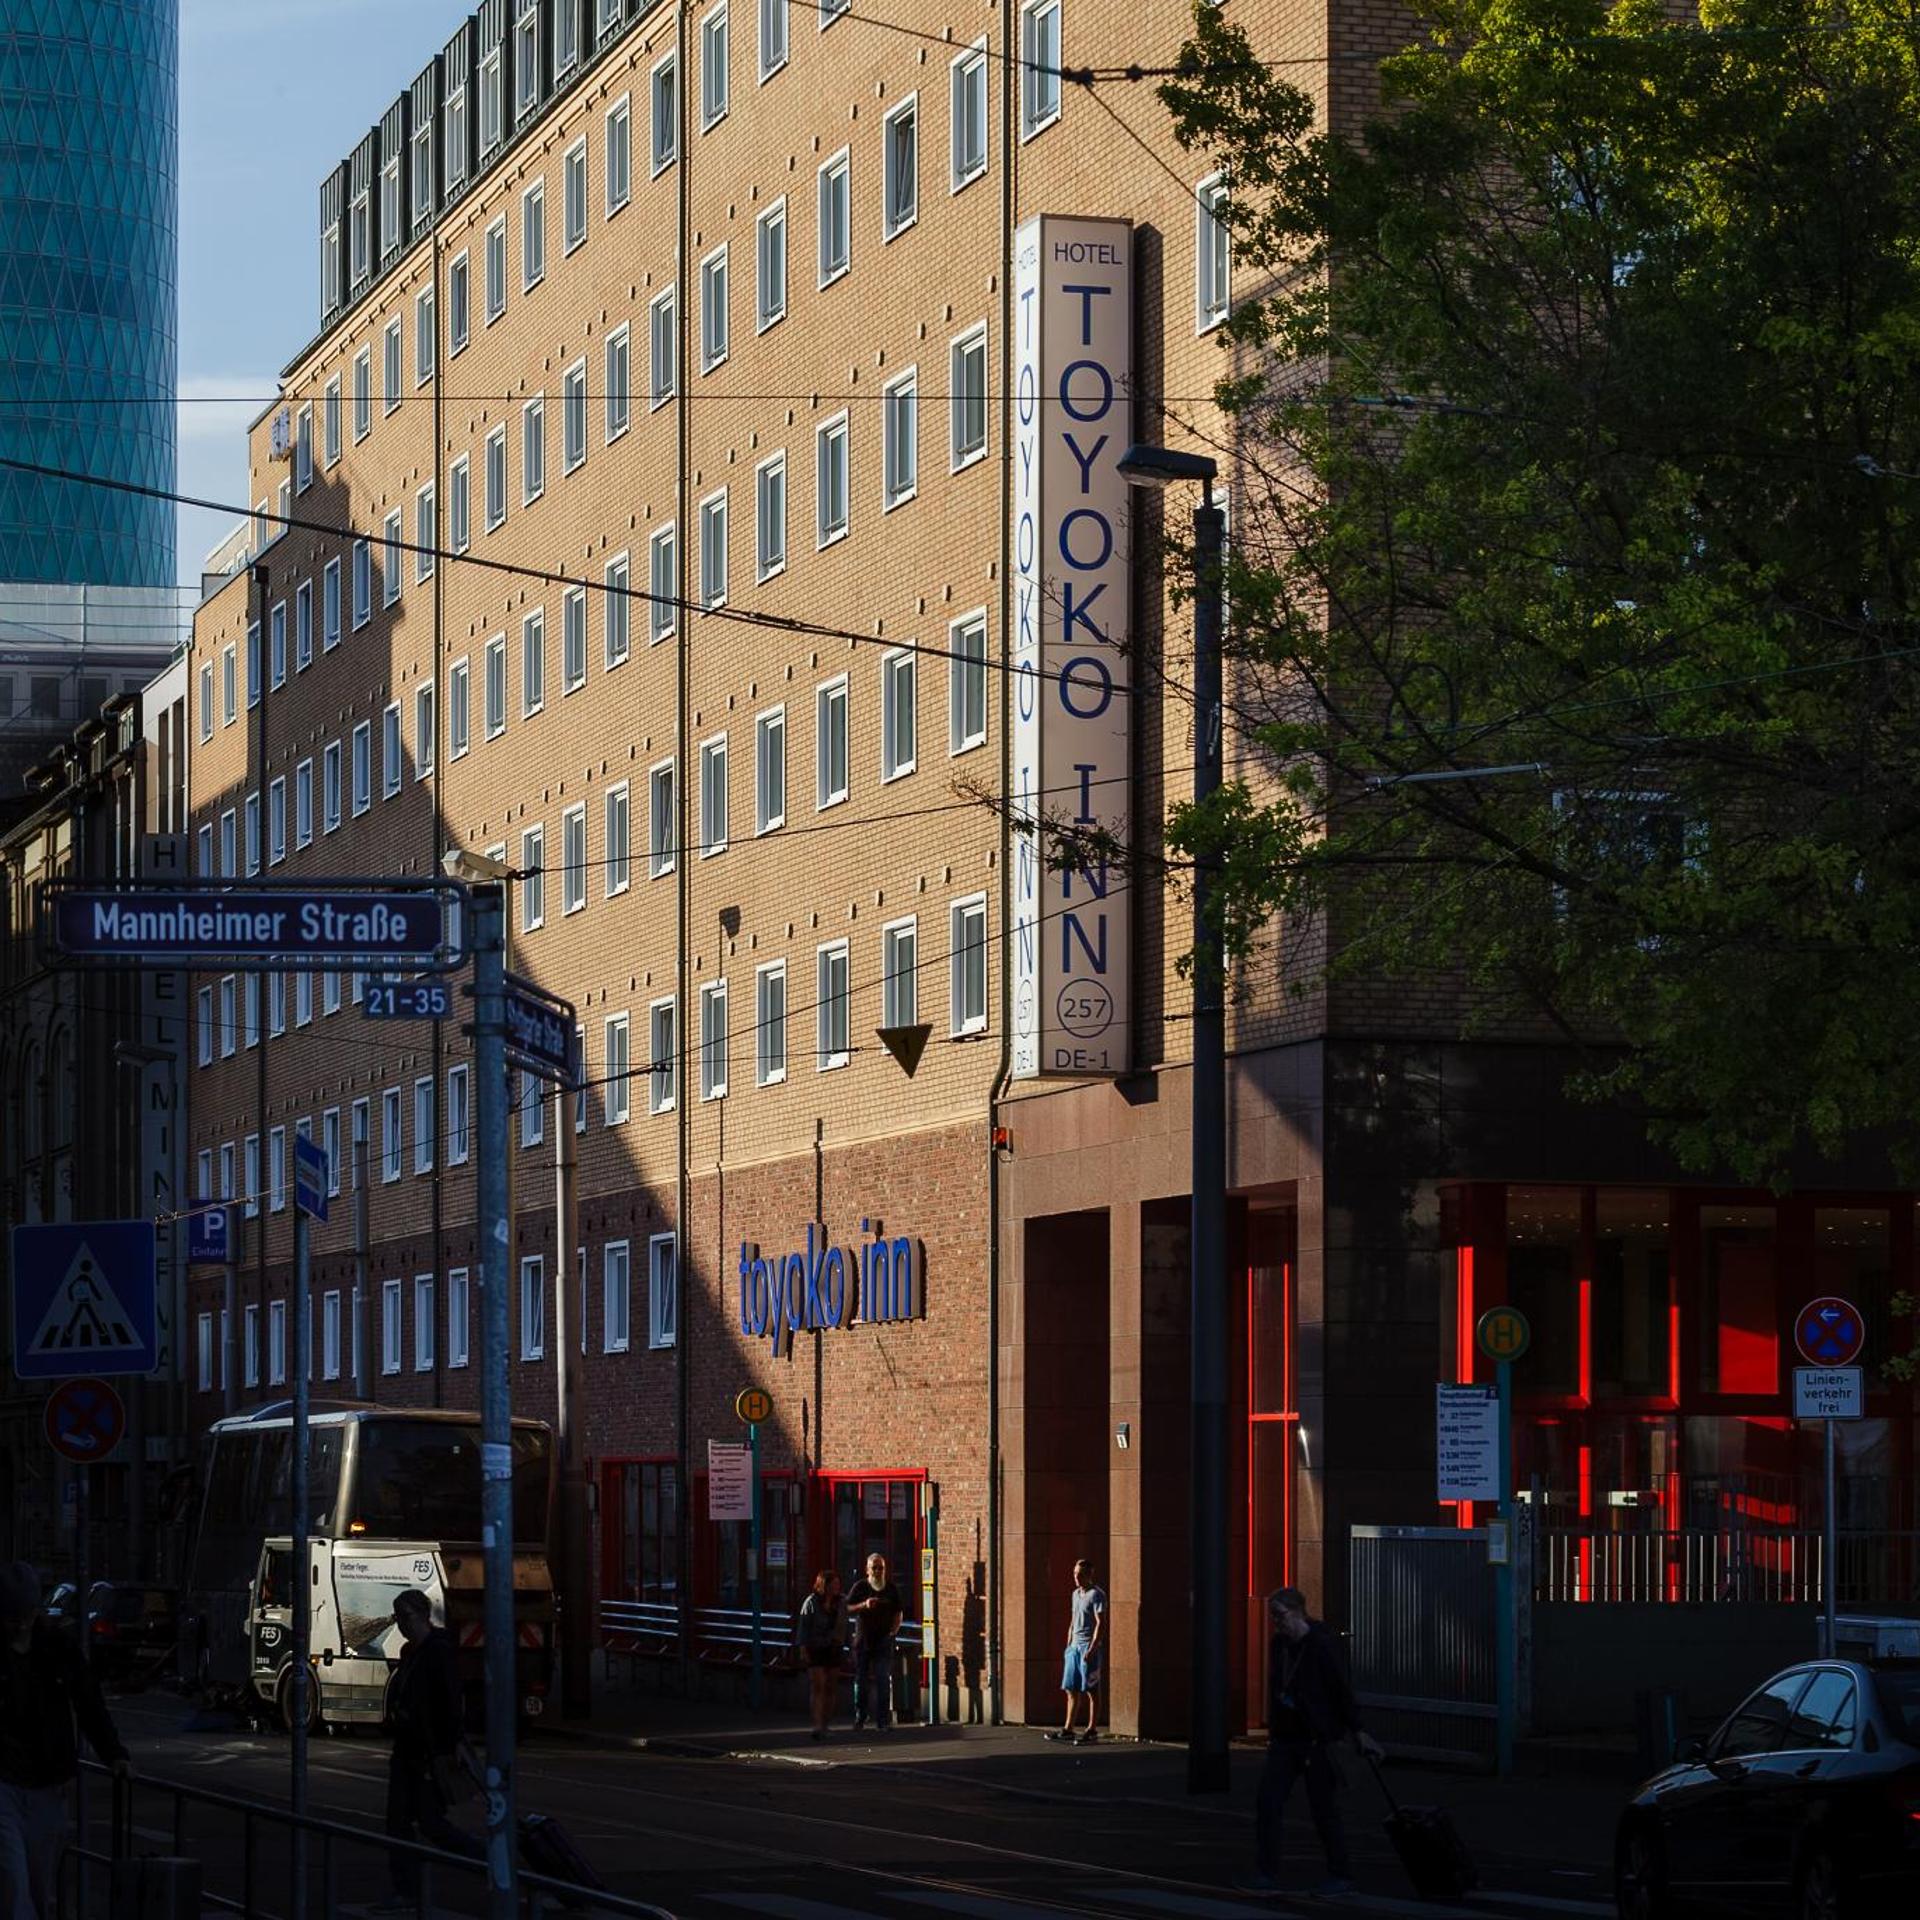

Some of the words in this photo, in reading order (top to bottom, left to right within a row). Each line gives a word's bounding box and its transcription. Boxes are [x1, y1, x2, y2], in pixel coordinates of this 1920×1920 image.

[1054, 242, 1122, 265] HOTEL
[1018, 287, 1035, 721] TOYOKO
[1059, 285, 1113, 720] TOYOKO
[1062, 764, 1107, 974] INN
[94, 902, 286, 942] Mannheimer
[300, 903, 408, 942] Straße
[154, 841, 176, 1043] HEL
[368, 988, 446, 1014] 21-35
[1063, 998, 1107, 1018] 257
[1055, 1049, 1111, 1069] DE-1
[203, 1212, 224, 1240] P
[192, 1246, 227, 1257] Einfahr
[739, 1222, 847, 1358] toyoko
[861, 1217, 914, 1322] inn
[1494, 1319, 1514, 1347] H
[1805, 1373, 1849, 1385] Linien-
[1803, 1387, 1852, 1399] verkehr
[749, 1395, 763, 1417] H
[1818, 1401, 1840, 1412] frei
[413, 1560, 430, 1573] FES
[260, 1626, 277, 1640] FES
